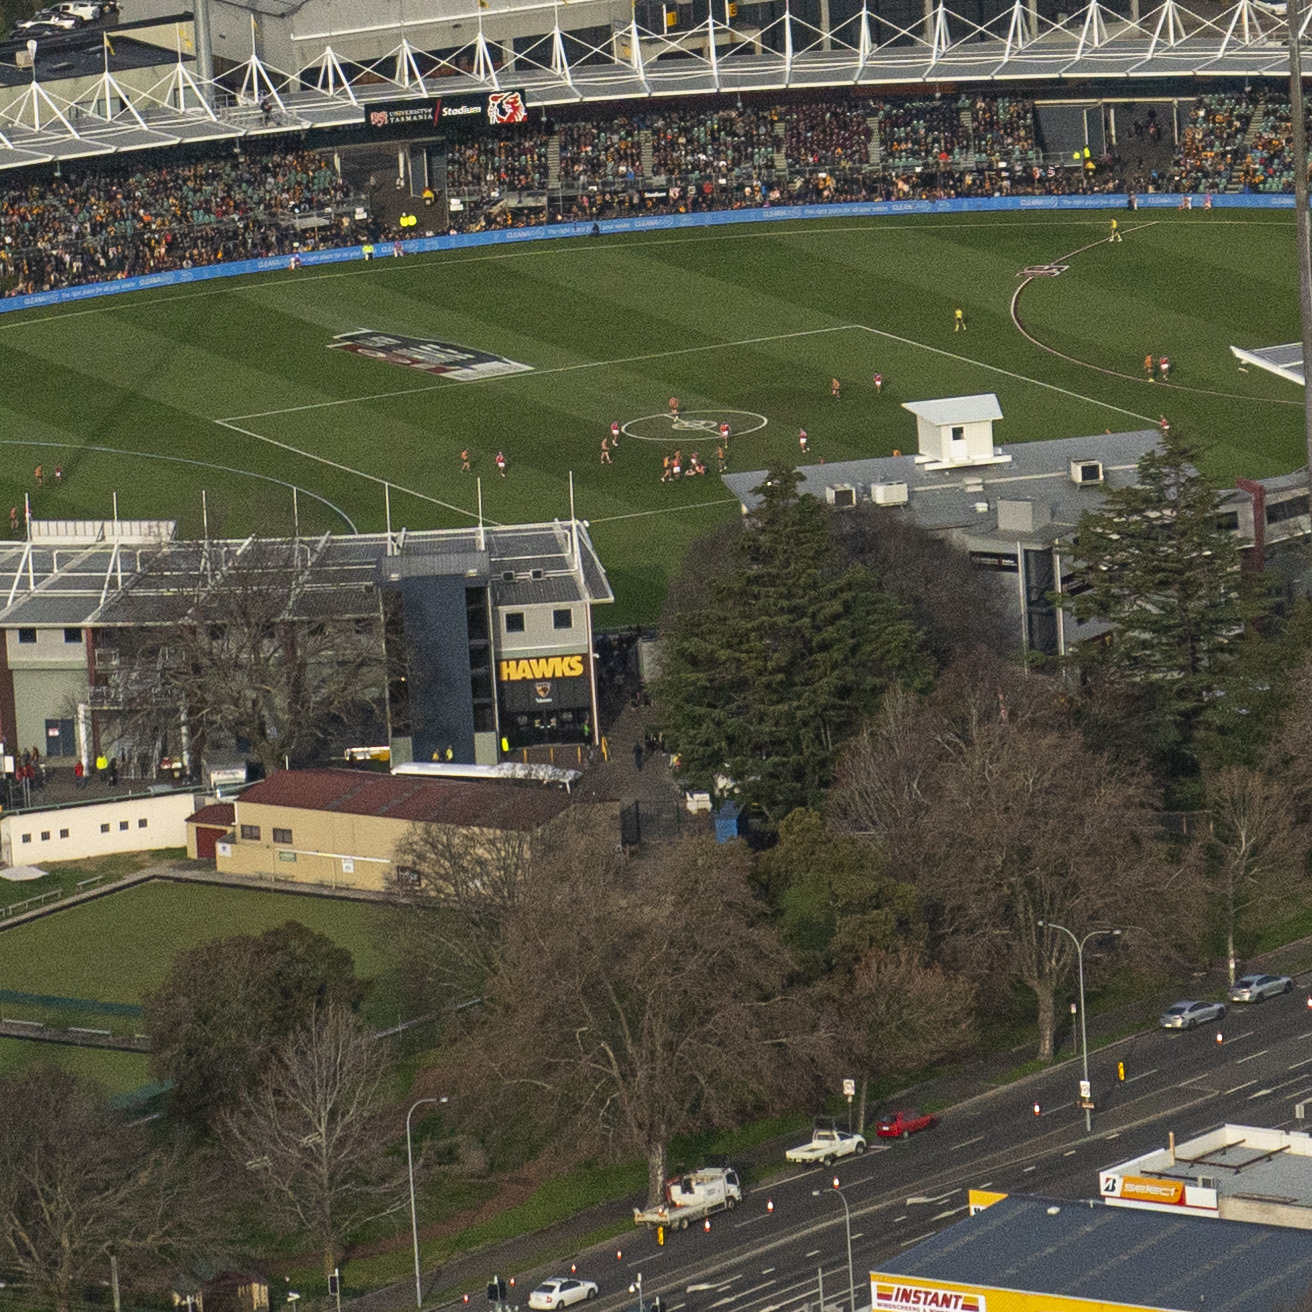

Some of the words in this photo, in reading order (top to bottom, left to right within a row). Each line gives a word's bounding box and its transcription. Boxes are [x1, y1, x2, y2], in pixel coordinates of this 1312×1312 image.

[389, 108, 425, 117] UNIVERSITY
[442, 105, 482, 117] Stadium
[390, 114, 434, 123] TASMANIA
[500, 655, 584, 681] HAWKS
[1124, 1182, 1176, 1197] select
[895, 1287, 963, 1310] INSTANT
